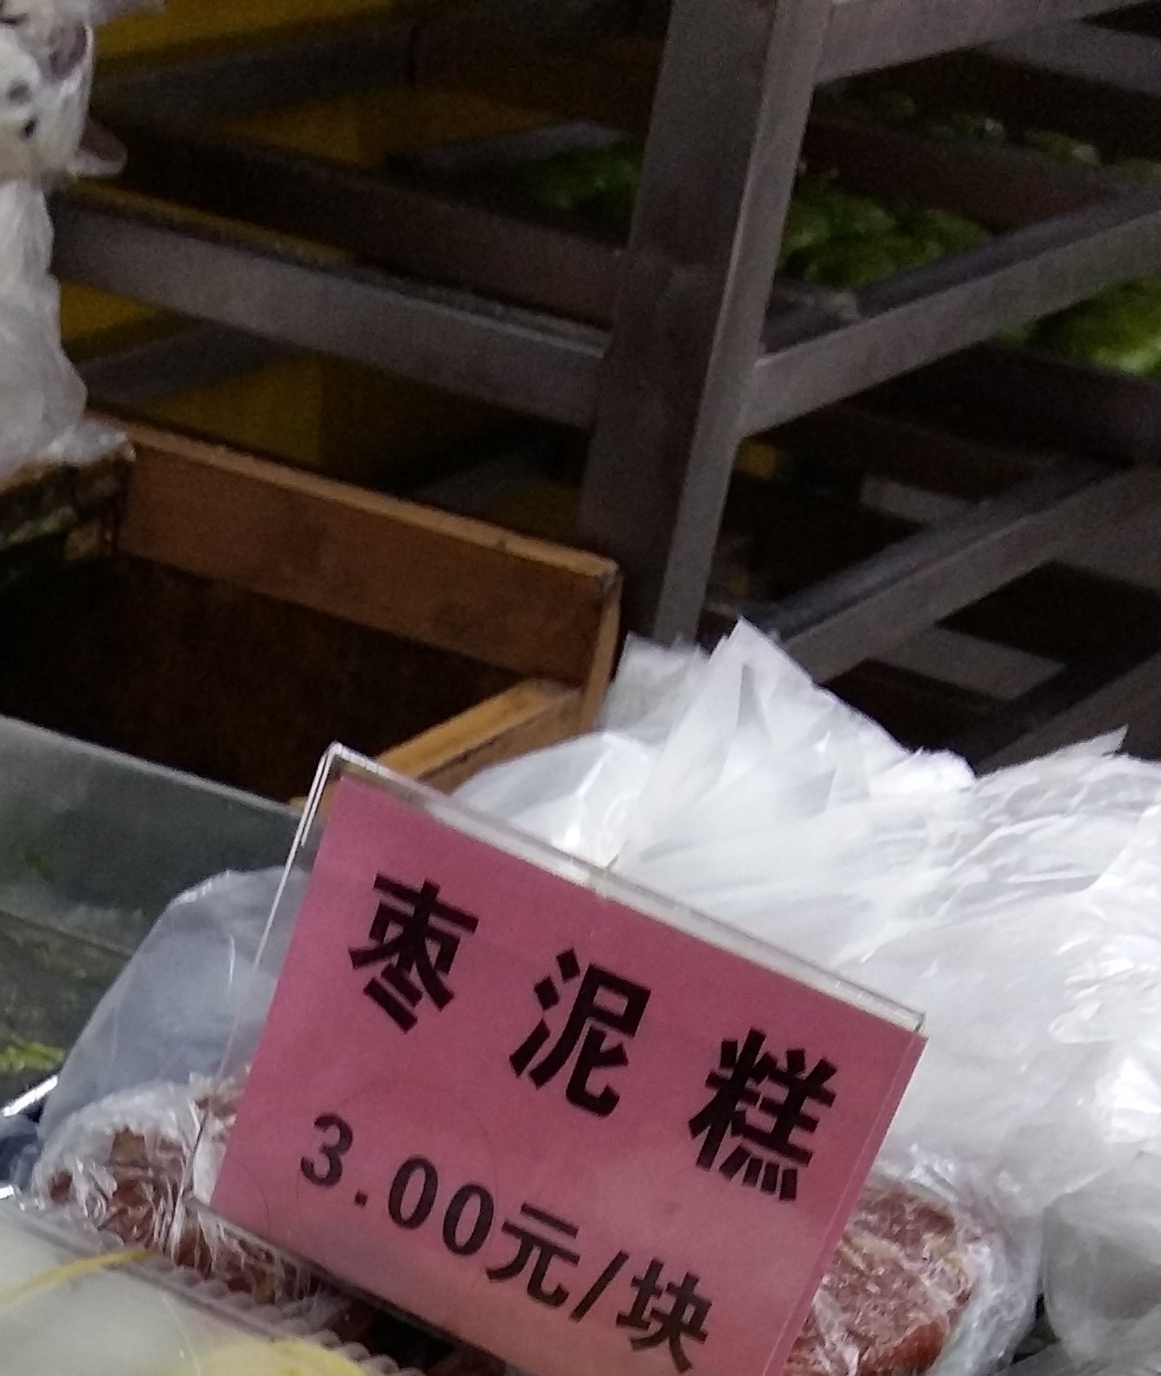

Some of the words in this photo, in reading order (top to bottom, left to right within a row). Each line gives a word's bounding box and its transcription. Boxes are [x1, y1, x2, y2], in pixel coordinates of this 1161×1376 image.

[347, 871, 838, 1203] 枣泥糕
[300, 1111, 713, 1374] 3.00元/块
